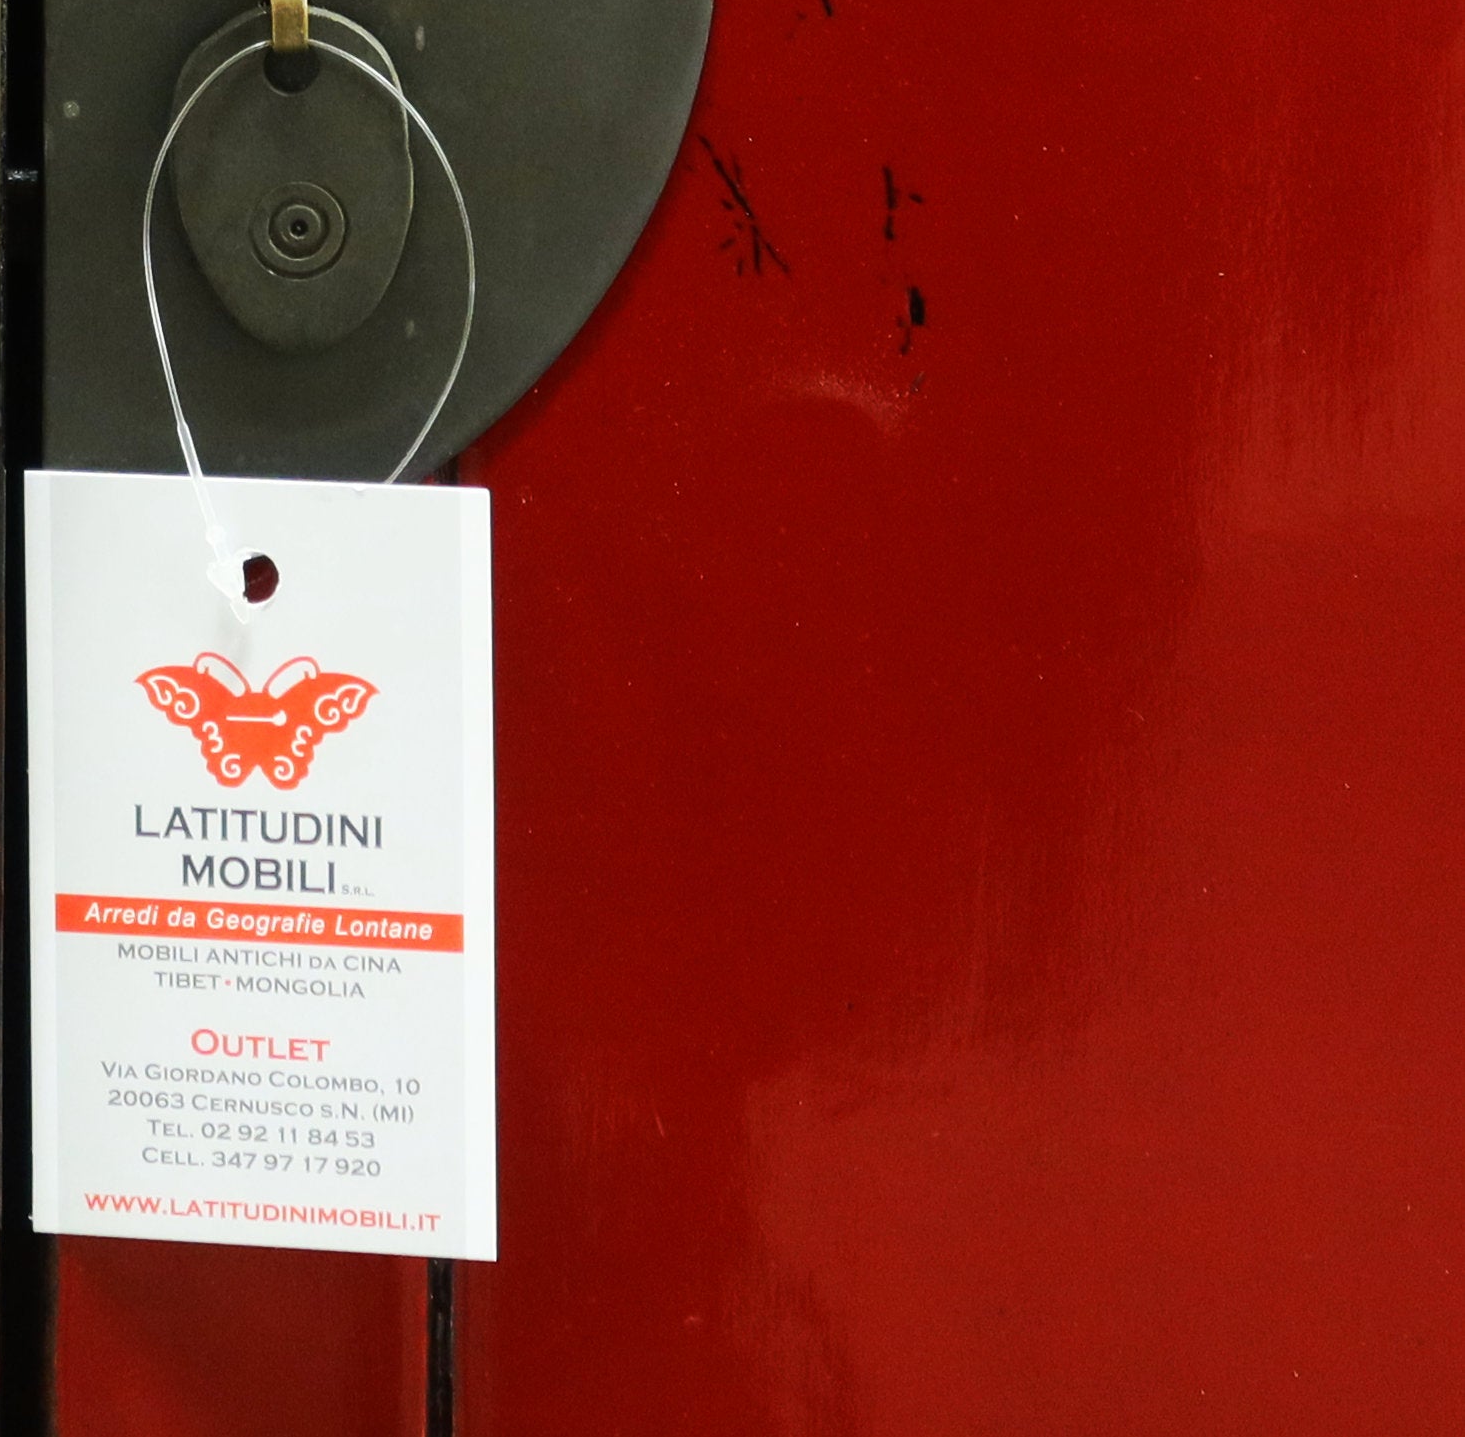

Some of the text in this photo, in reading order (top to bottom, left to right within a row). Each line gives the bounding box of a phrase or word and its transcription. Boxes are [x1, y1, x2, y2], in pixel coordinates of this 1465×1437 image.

[134, 804, 382, 849] LATITUDINI
[182, 854, 375, 897] MOBILI S.R.L.
[85, 903, 432, 940] Arredi da Geografie Lontane
[118, 943, 198, 962] MOBILI
[206, 948, 301, 968] ANTICHI
[343, 955, 401, 973] CINA
[269, 1071, 384, 1095] COLOMBO,
[396, 1078, 420, 1095] 10
[108, 1089, 184, 1109] 20063
[373, 1104, 414, 1123] (MI)
[201, 1122, 231, 1140] 02
[238, 1125, 268, 1142] 92
[279, 1127, 296, 1144] 11
[308, 1129, 338, 1146] 84
[346, 1131, 374, 1148] 53
[212, 1151, 257, 1169] 347
[264, 1154, 293, 1171] 97
[305, 1156, 328, 1173] 17
[335, 1158, 381, 1176] 920
[84, 1193, 441, 1231] WWW.LATITUDINIMOBILI.IT
